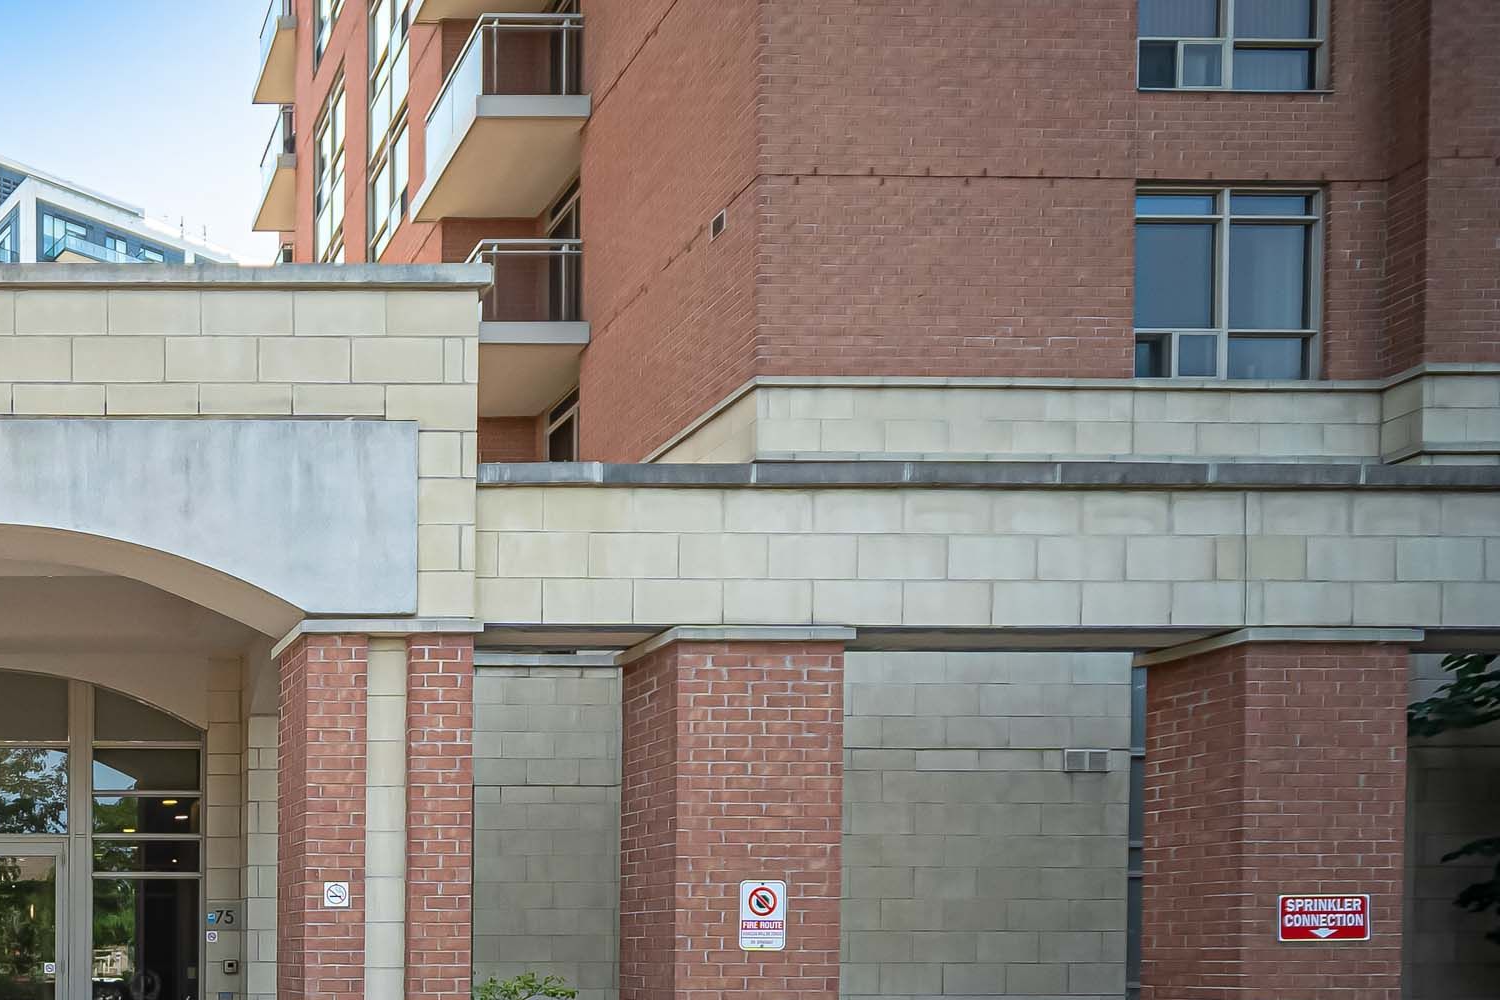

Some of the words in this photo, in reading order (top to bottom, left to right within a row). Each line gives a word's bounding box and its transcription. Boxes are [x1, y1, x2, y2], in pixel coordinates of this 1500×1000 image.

[1285, 898, 1362, 912] SPRINKLER
[215, 909, 235, 924] 75
[1283, 913, 1364, 927] CONNECTION
